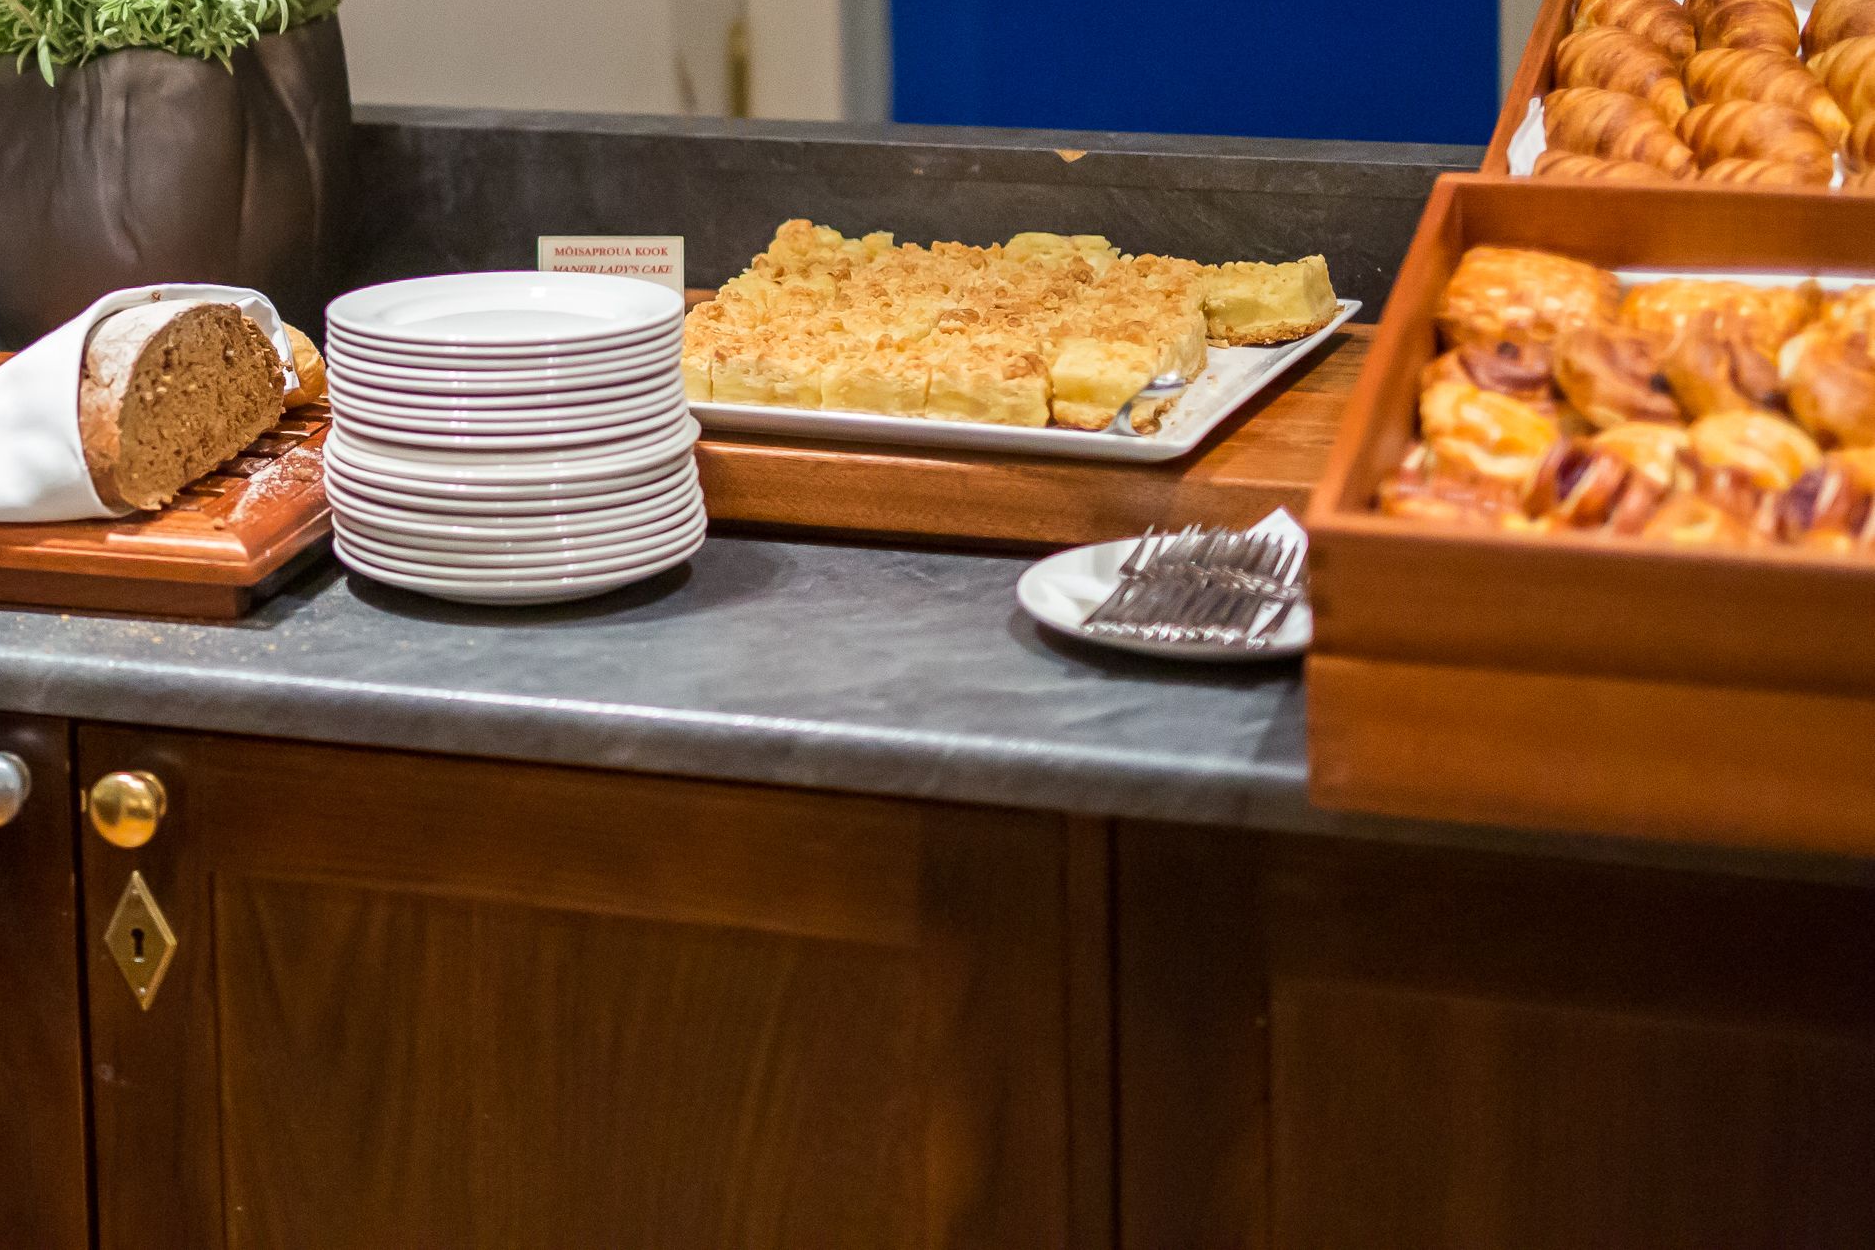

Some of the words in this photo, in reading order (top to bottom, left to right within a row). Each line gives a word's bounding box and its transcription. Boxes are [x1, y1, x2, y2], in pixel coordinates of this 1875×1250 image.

[635, 247, 669, 257] KOOK
[552, 265, 597, 274] MANOR
[641, 265, 673, 274] CAKE
